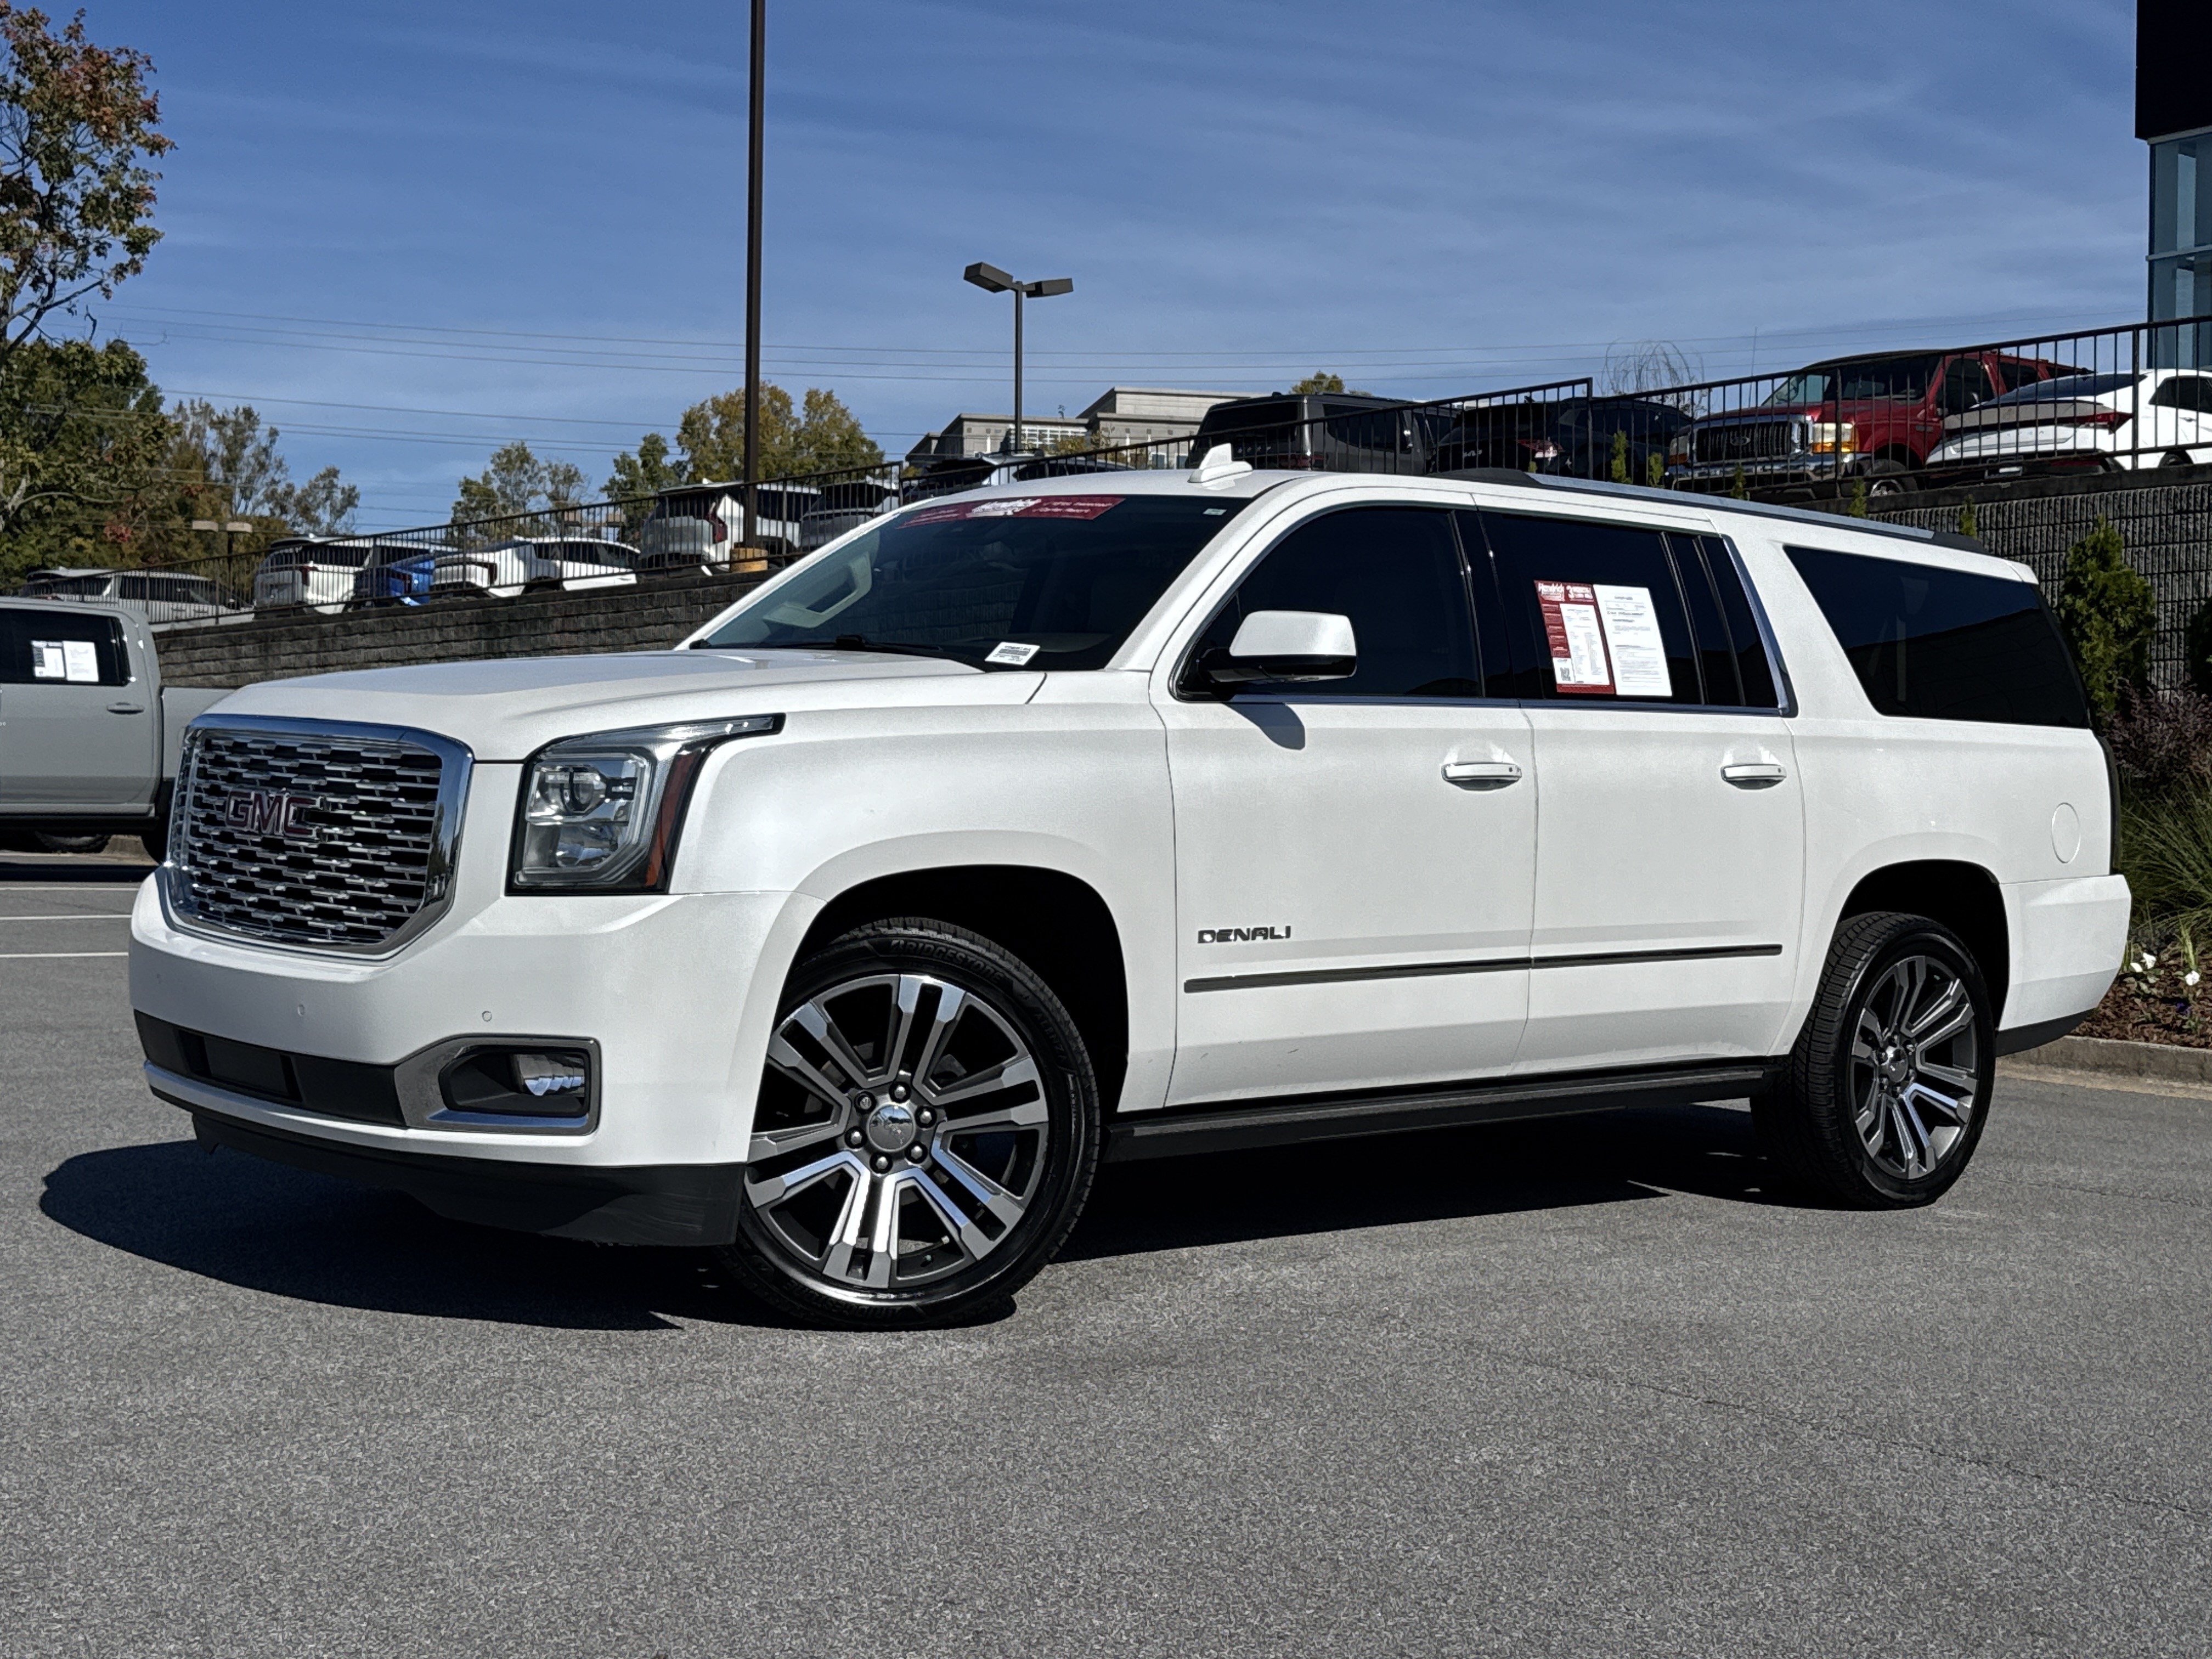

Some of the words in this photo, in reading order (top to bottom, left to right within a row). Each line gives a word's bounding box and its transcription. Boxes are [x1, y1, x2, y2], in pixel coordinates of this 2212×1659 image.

[225, 789, 323, 838] GMC
[1198, 926, 1291, 944] DENALI
[889, 939, 1009, 985] BRIDGESTONE
